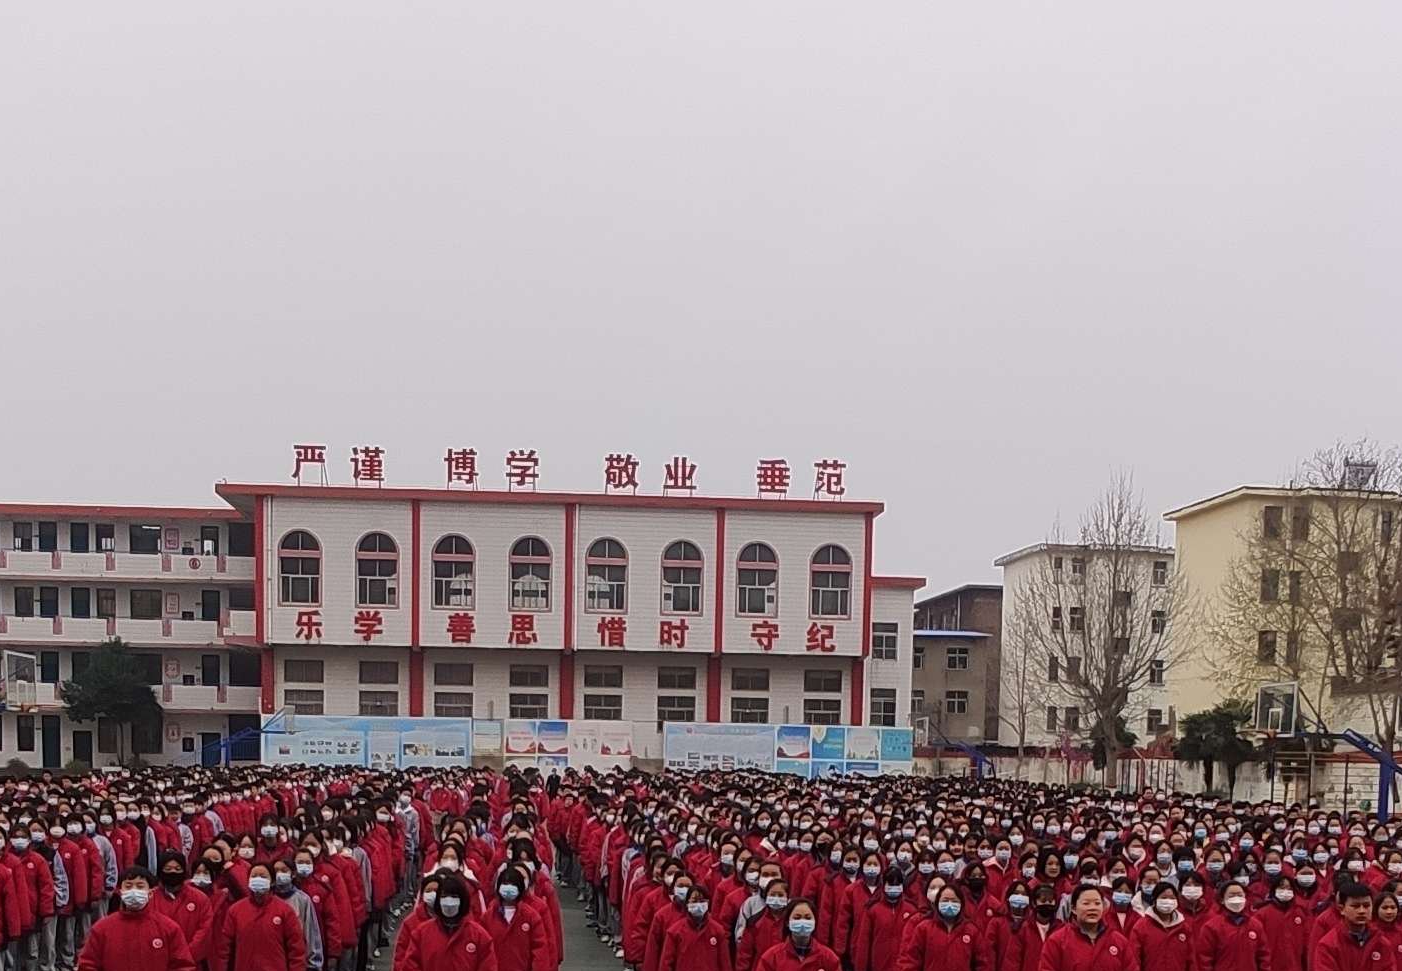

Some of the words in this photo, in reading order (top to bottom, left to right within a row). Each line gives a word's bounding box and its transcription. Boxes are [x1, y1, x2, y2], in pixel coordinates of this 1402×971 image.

[291, 444, 385, 482] 严谨
[443, 447, 540, 486] 博学
[604, 453, 697, 490] 敬业
[756, 459, 847, 496] 垂范
[295, 610, 384, 642] 乐学
[446, 612, 538, 645] 善思
[596, 616, 690, 649] 惜时
[750, 620, 836, 652] 守纪
